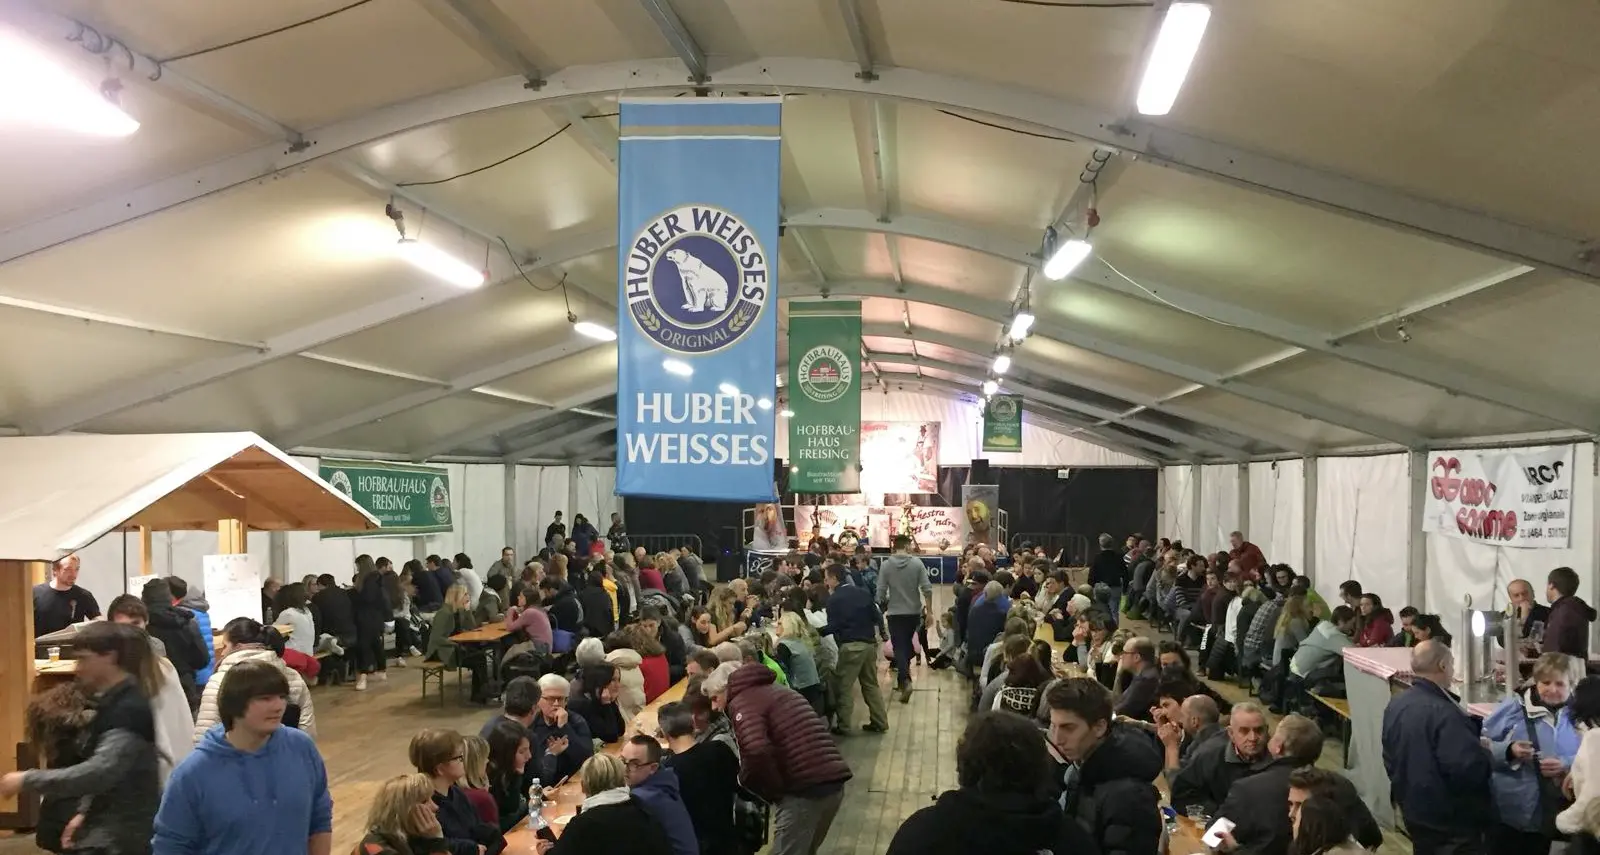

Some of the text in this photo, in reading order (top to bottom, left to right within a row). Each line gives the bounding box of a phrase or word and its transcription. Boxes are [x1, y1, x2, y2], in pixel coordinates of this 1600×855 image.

[627, 207, 767, 303] HUBER WEISSES
[660, 327, 731, 348] ORIGINAL
[800, 347, 850, 381] HOFBRAUHAUS
[637, 391, 757, 425] HUBER
[796, 425, 856, 436] HOFBRAU-
[625, 432, 768, 466] WEISSES
[808, 437, 840, 448] HAUS
[799, 449, 849, 460] FREISING
[358, 475, 427, 494] HOFBRAUHAUS
[372, 494, 411, 511] FREISING
